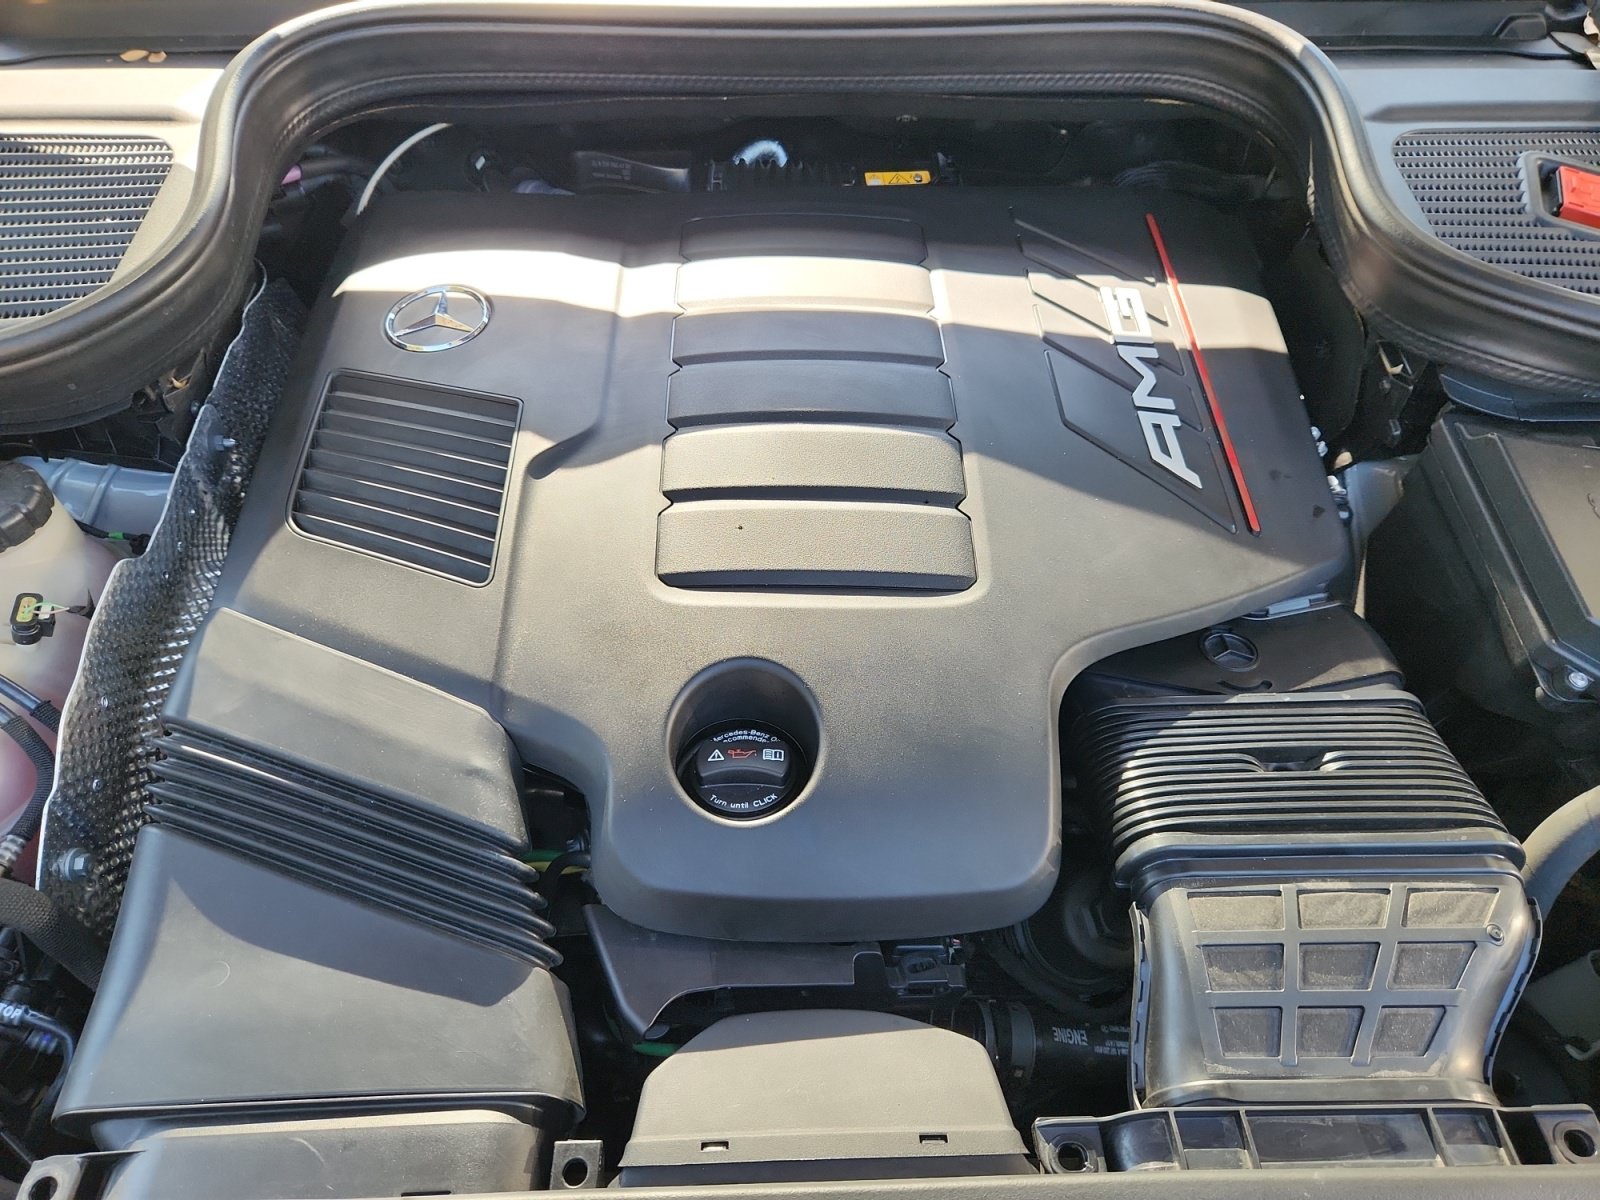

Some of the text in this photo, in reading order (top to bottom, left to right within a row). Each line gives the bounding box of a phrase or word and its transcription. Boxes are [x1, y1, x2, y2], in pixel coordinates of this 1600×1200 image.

[1100, 286, 1203, 489] AMG
[710, 793, 778, 809] Turn until CLICK
[1052, 1026, 1088, 1046] ENGINE
